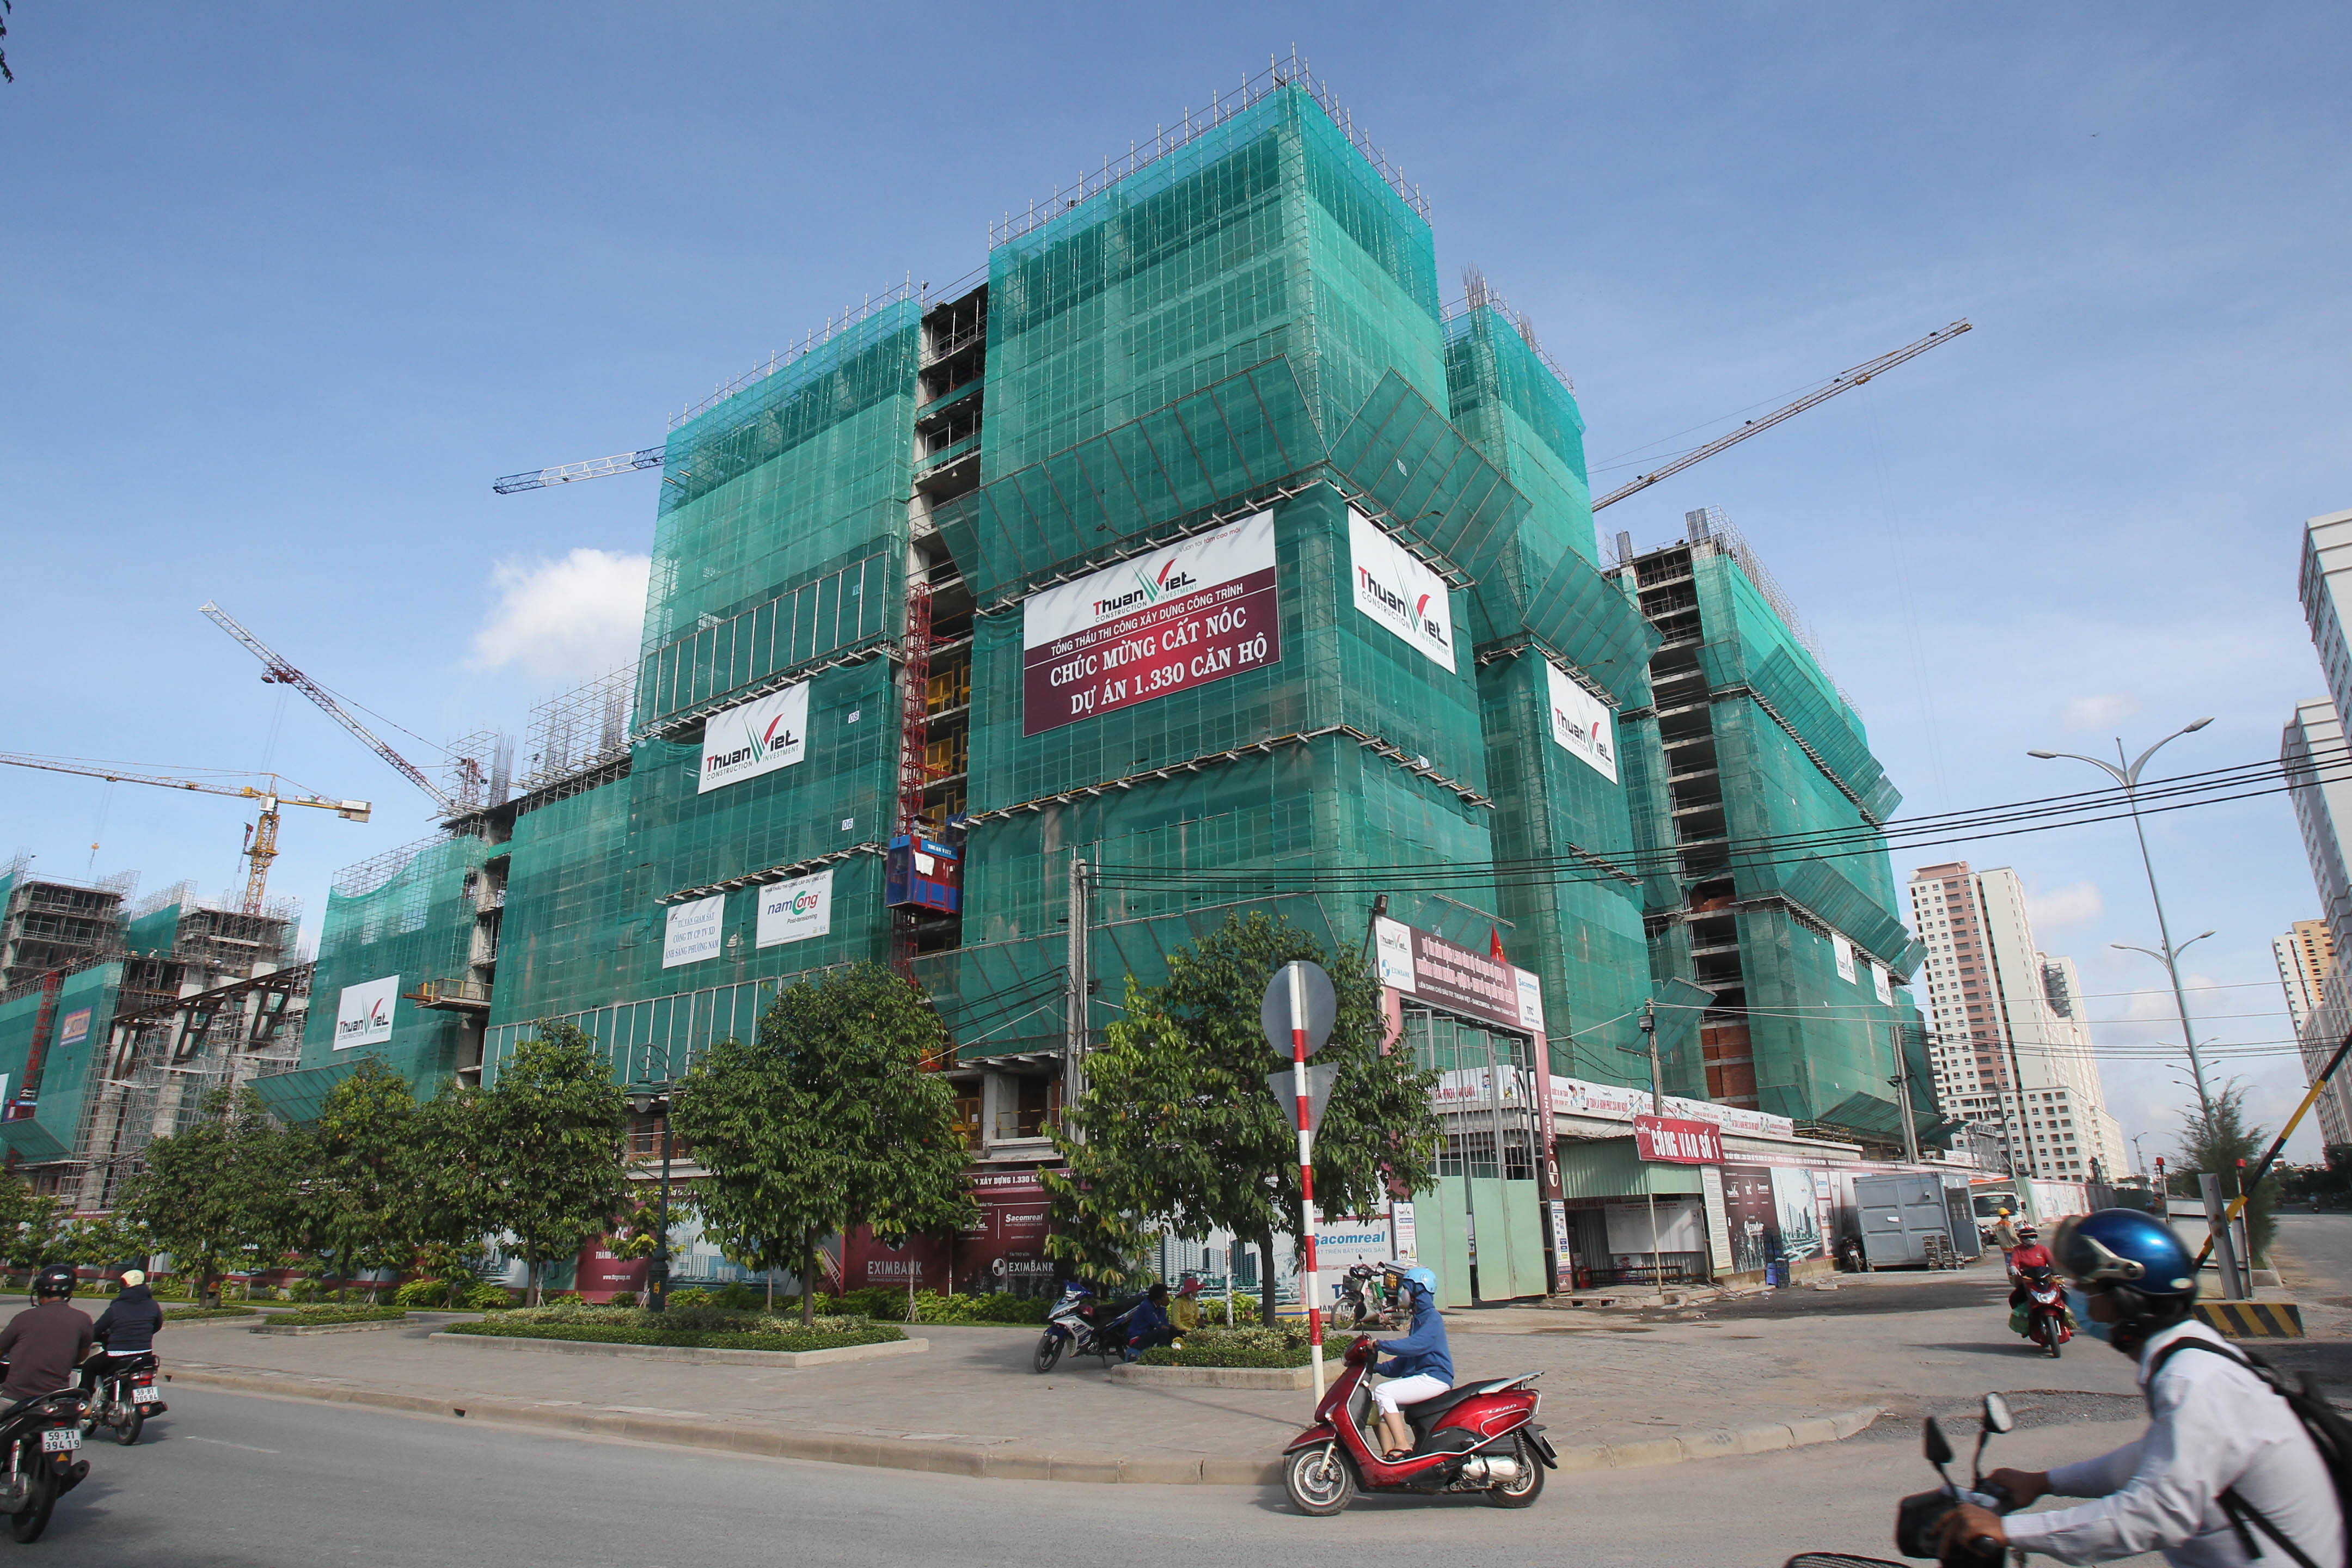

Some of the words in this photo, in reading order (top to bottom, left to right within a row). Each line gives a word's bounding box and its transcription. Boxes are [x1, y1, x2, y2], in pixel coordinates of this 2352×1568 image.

[1095, 601, 1147, 623] CONSTRUCTION
[1159, 584, 1197, 602] INVESTMENT
[1051, 639, 1073, 656] TỔNG
[1075, 630, 1097, 648] THẦU
[1098, 627, 1111, 640] THI
[1113, 618, 1138, 635] CÔNG
[1140, 611, 1157, 627] XÂY
[1160, 603, 1185, 620] DỰNG
[1187, 593, 1213, 610] CÔNG
[1215, 583, 1243, 601] TRÌNH
[1362, 591, 1410, 630] CONSTRUCTION
[1419, 630, 1449, 657] INVESTMENT
[1050, 654, 1098, 687] CHÚC
[1102, 636, 1156, 670] MỪNG
[1162, 617, 1200, 651] CẤT
[1205, 606, 1247, 638] NÓC
[1071, 685, 1097, 715] DỰ
[1101, 678, 1127, 706] ÁN
[1135, 662, 1185, 696] 1.330
[1191, 647, 1232, 678] CĂN
[1238, 632, 1267, 664] HỘ
[849, 712, 858, 722] 08
[706, 761, 753, 781] CONSTRUCTION
[763, 744, 799, 763] INVESTMENT
[843, 819, 852, 829] 06
[786, 913, 818, 925] Post-tensioning
[1651, 1121, 1679, 1157] CỔNG
[1678, 1128, 1699, 1158] VÀO
[1699, 1128, 1712, 1159] SỐ
[1712, 1136, 1720, 1159] 1
[979, 1177, 992, 1185] XÂY
[994, 1175, 1011, 1186] DỰNG
[1013, 1175, 1030, 1184] 1.330
[1006, 1213, 1043, 1223] Sacomreal
[1314, 1230, 1385, 1247] Sacomreal
[1009, 1262, 1054, 1272] EXIMBANK
[136, 1393, 158, 1403] 205.84
[1488, 1404, 1517, 1414] LEAD
[48, 1431, 75, 1441] 59-X1
[46, 1440, 79, 1450] 394.19
